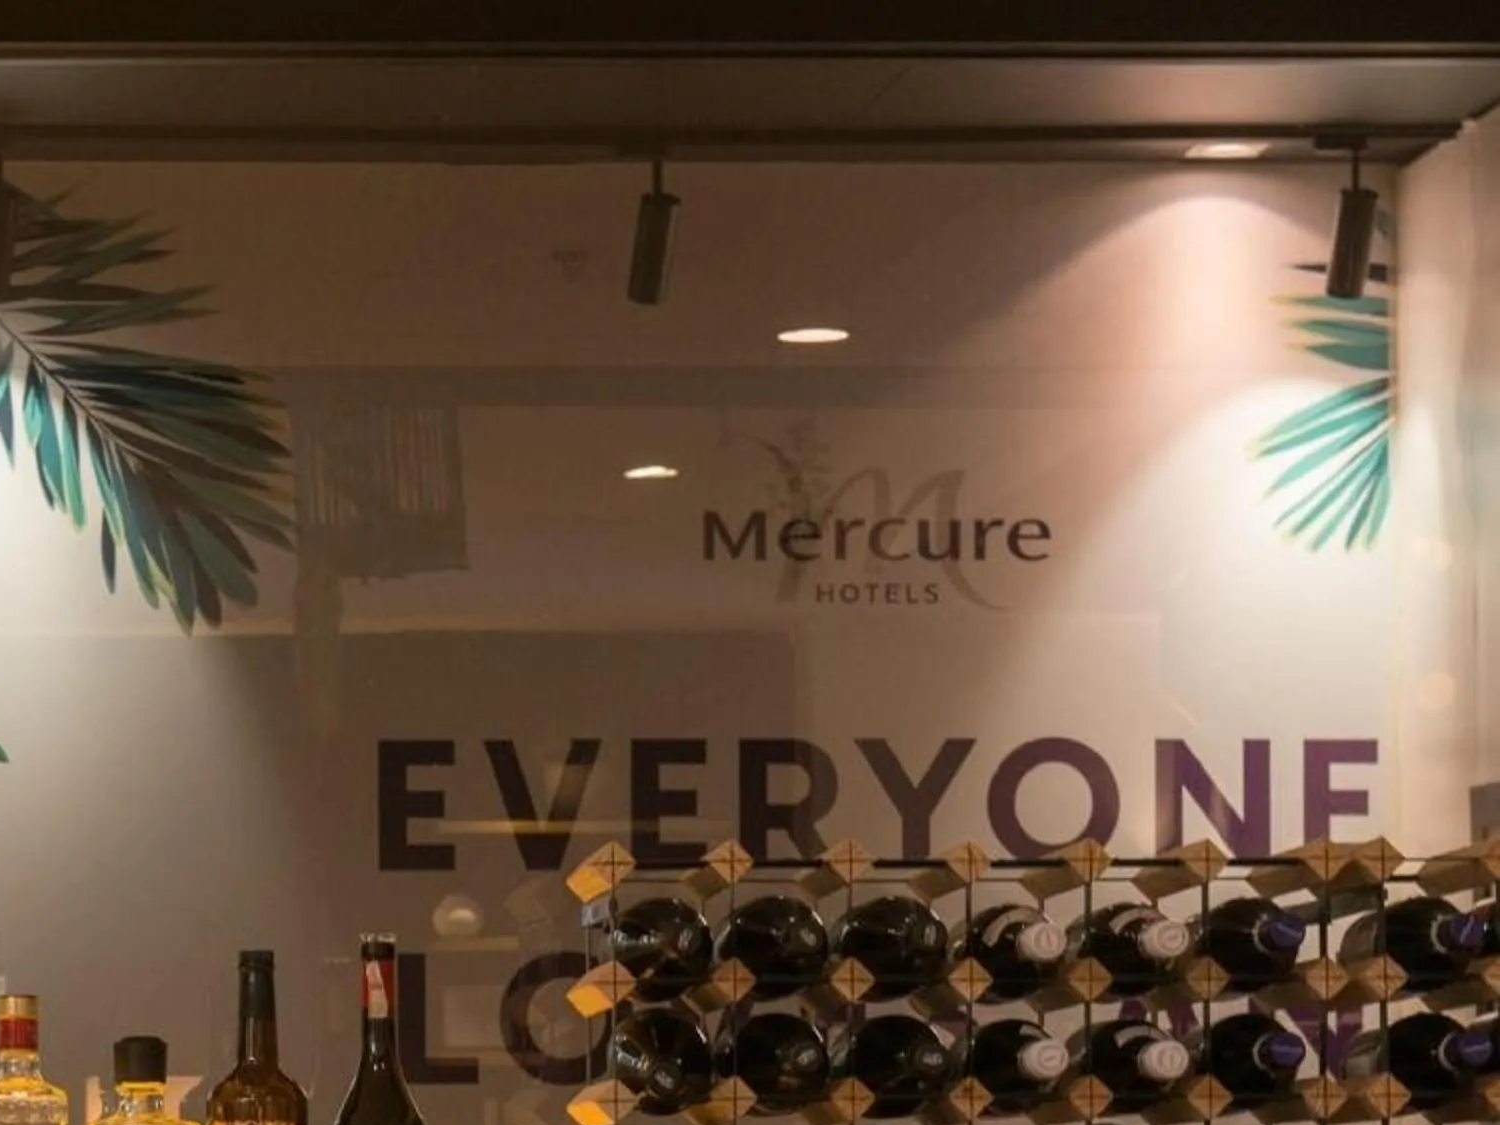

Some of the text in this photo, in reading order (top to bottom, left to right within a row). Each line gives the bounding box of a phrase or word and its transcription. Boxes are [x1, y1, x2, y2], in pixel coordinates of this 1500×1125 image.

[703, 510, 1052, 562] Mercure
[816, 582, 940, 605] HOTELS
[376, 737, 1380, 873] EVERYONE
